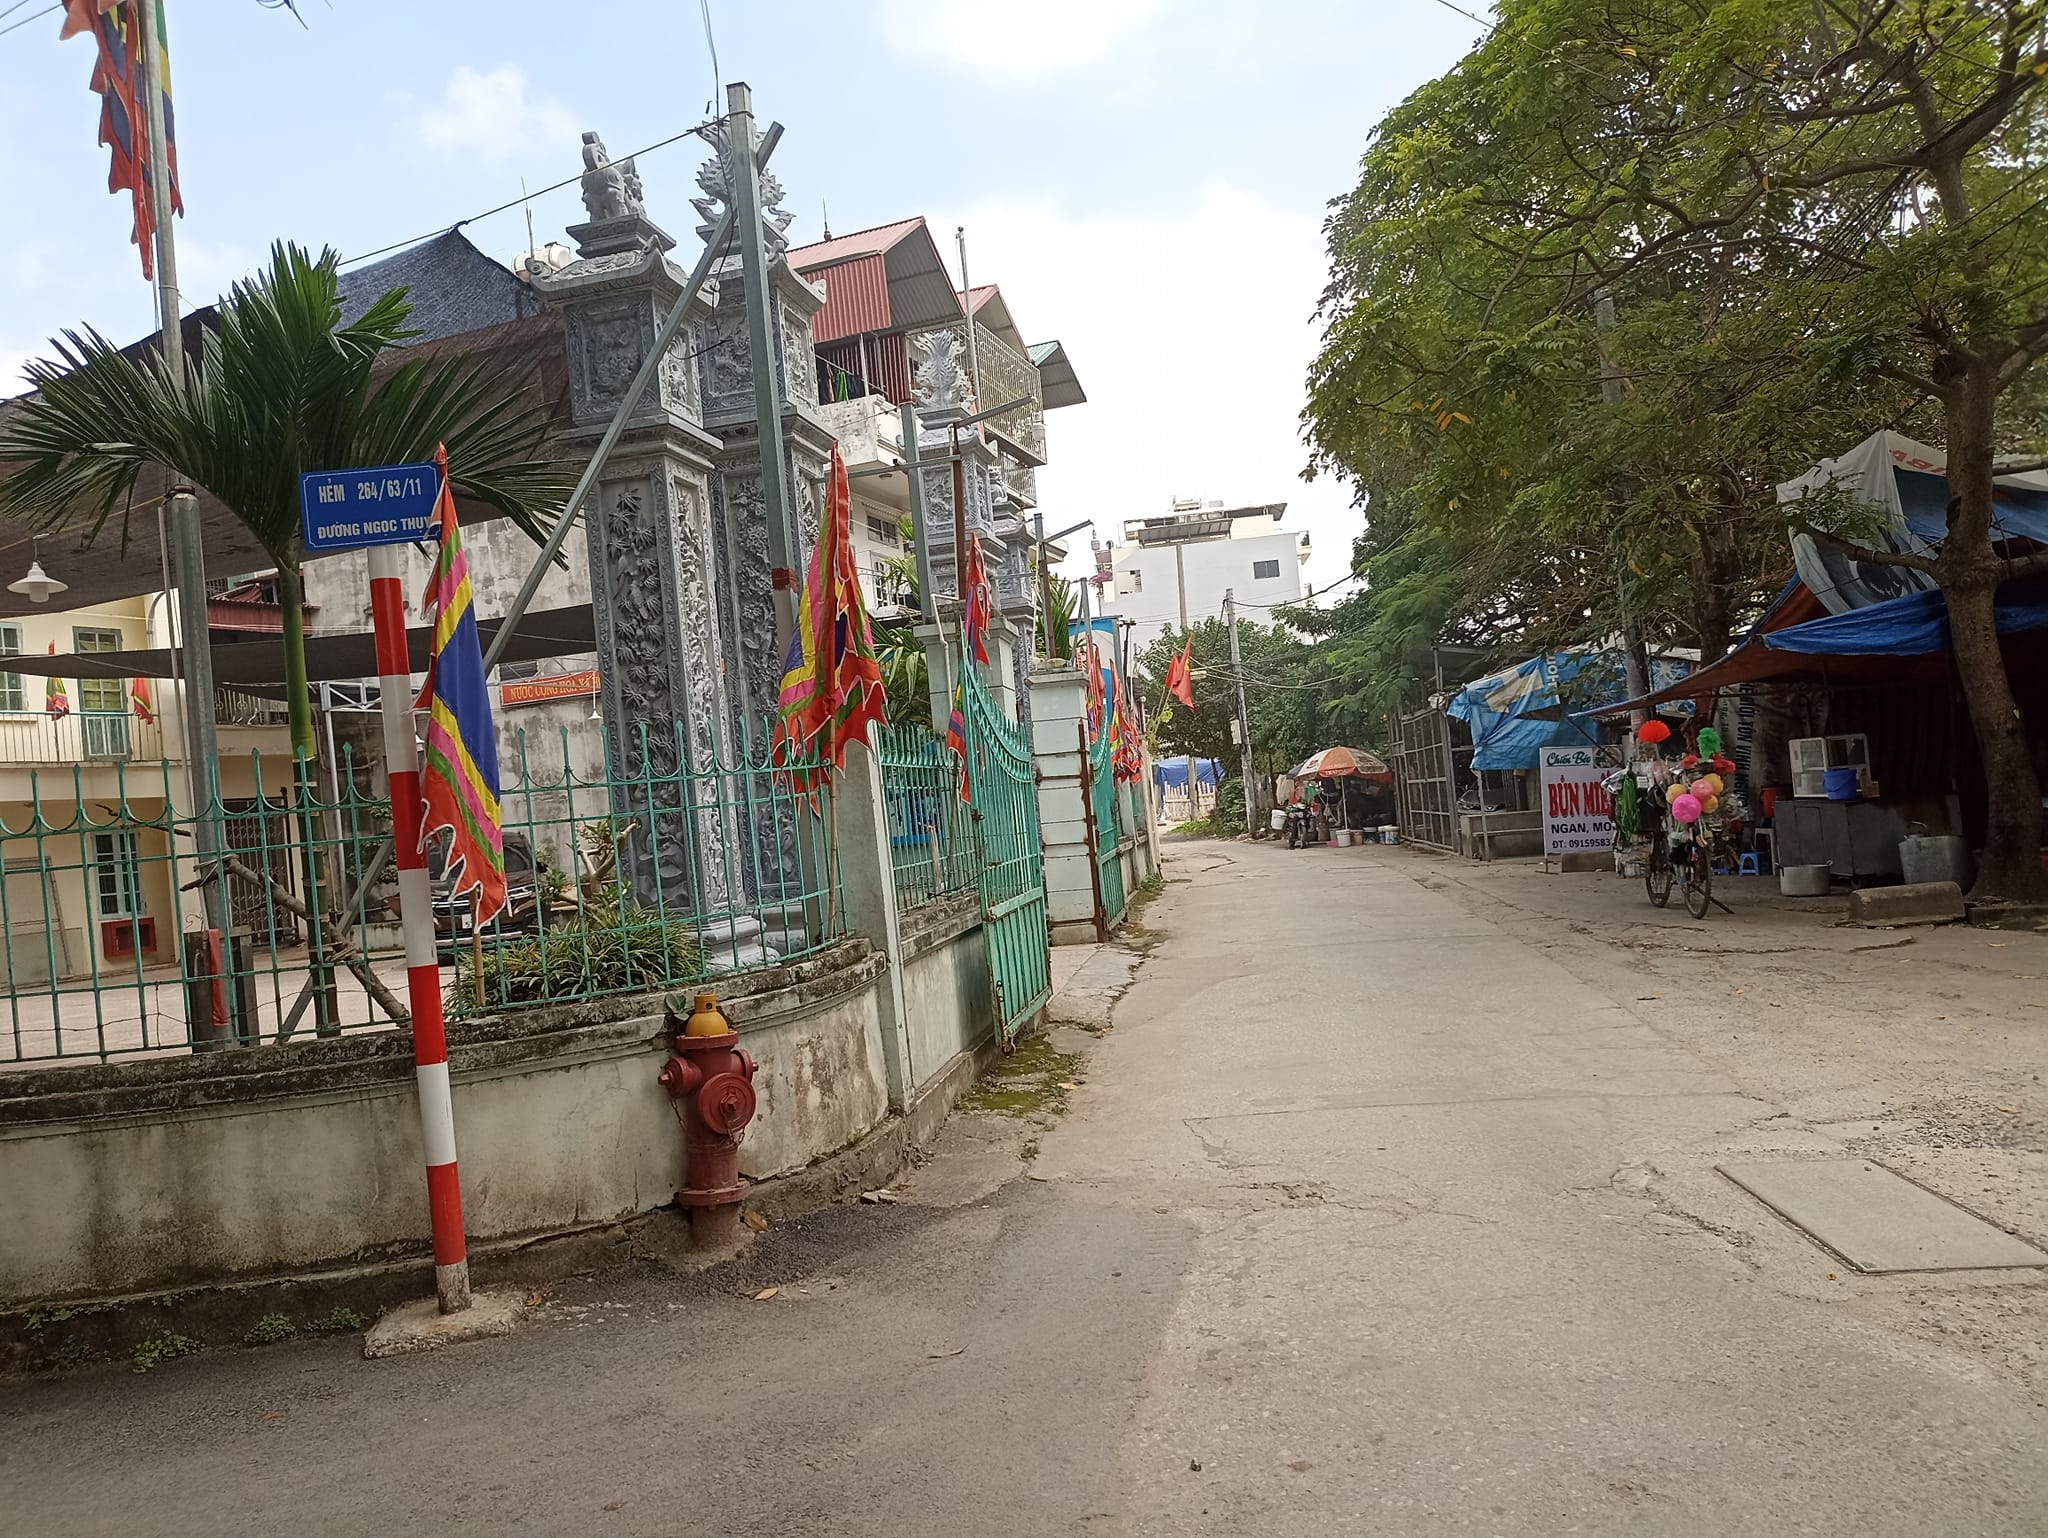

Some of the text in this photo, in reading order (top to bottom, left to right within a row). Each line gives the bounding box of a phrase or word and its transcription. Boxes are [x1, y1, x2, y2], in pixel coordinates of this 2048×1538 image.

[318, 477, 422, 503] HẺM 264/63/11
[317, 522, 361, 539] ĐƯỜNG
[363, 519, 398, 536] NGỌC
[1551, 822, 1616, 835] NGAN, MỌ
[1552, 838, 1616, 849] ĐT: 09159583
